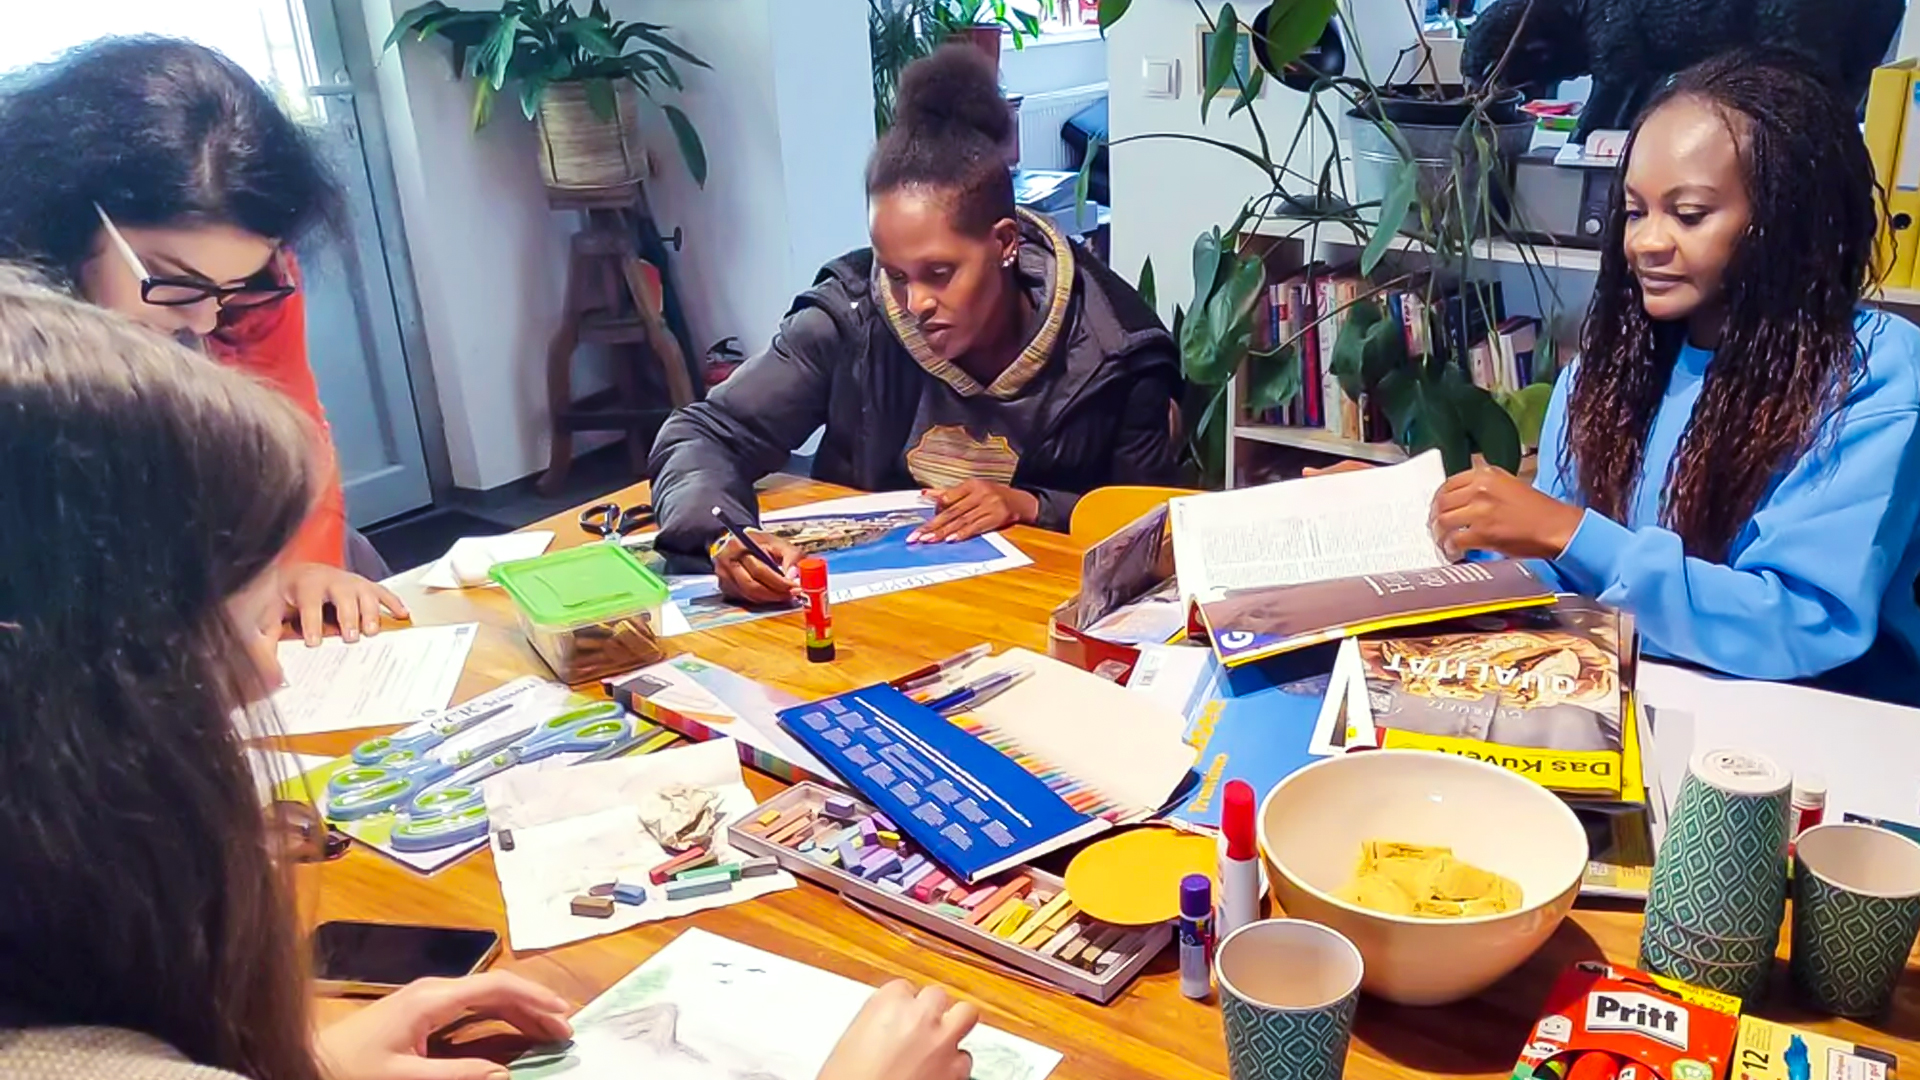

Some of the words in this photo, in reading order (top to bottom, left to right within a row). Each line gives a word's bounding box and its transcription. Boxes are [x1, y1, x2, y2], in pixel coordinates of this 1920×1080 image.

[1551, 759, 1611, 776] Das
[1595, 995, 1678, 1032] Pritt
[1741, 1049, 1769, 1070] 12
